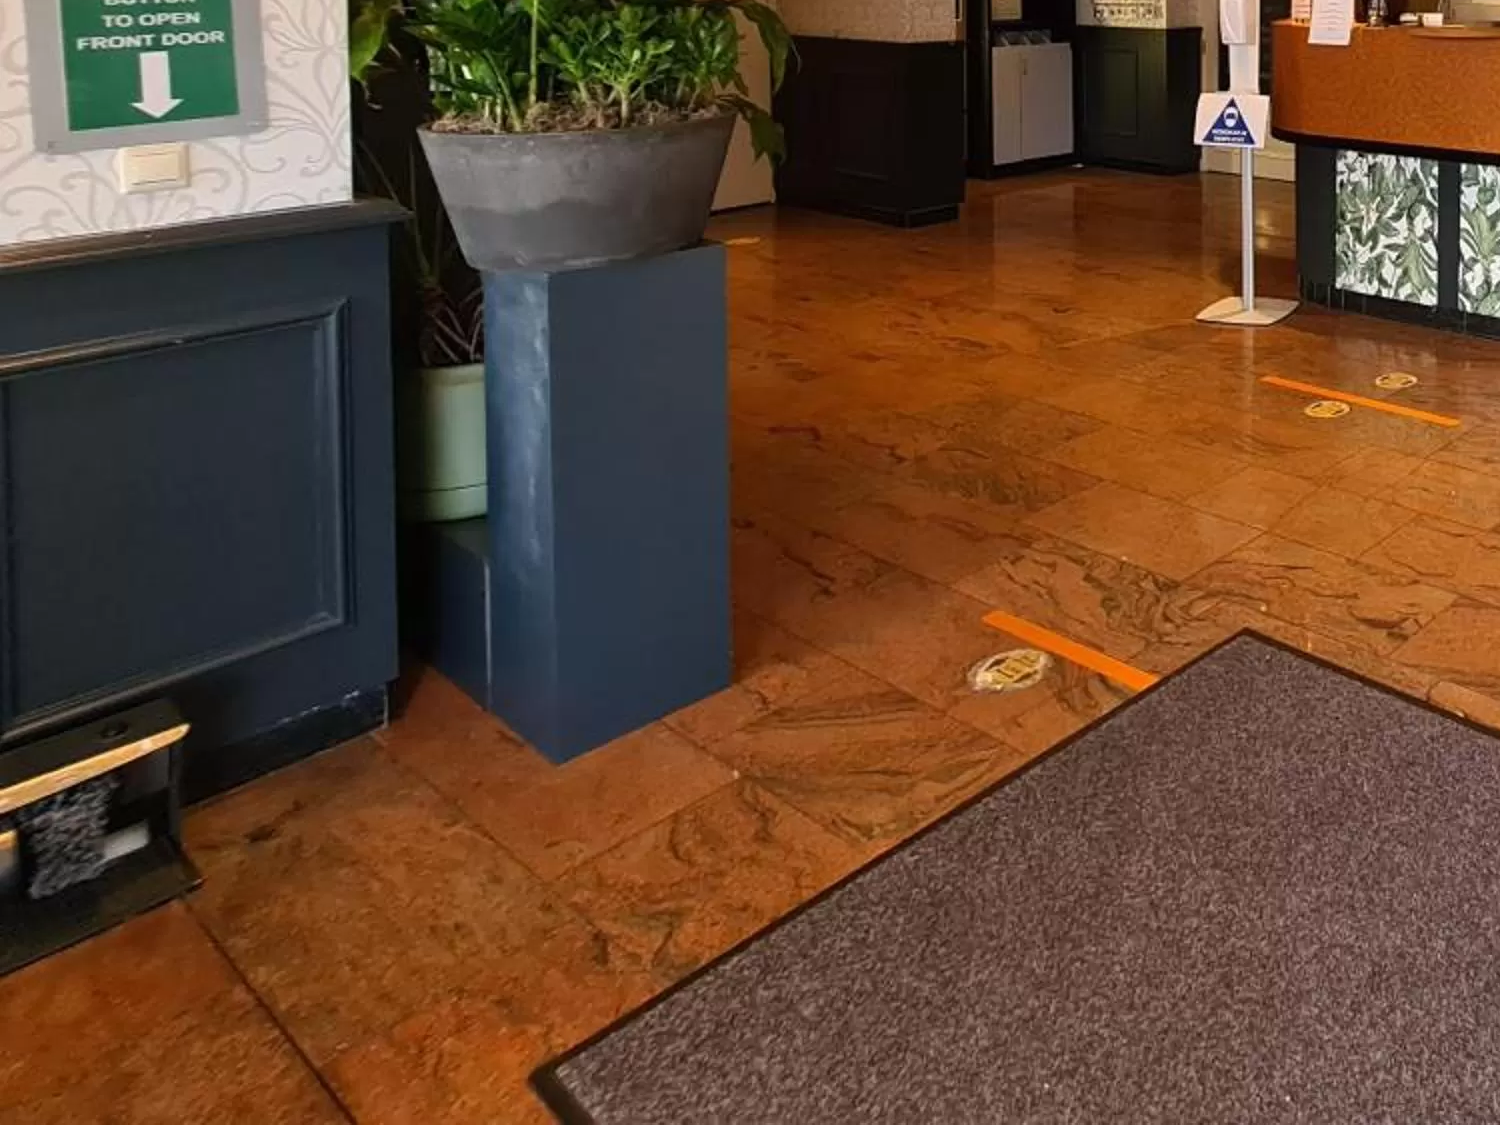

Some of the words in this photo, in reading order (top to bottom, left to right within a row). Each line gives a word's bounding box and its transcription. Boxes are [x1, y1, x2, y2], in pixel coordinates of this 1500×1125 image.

[102, 14, 134, 28] TO
[138, 12, 201, 26] OPEN
[76, 34, 156, 50] FRONT
[161, 30, 225, 46] DOOR
